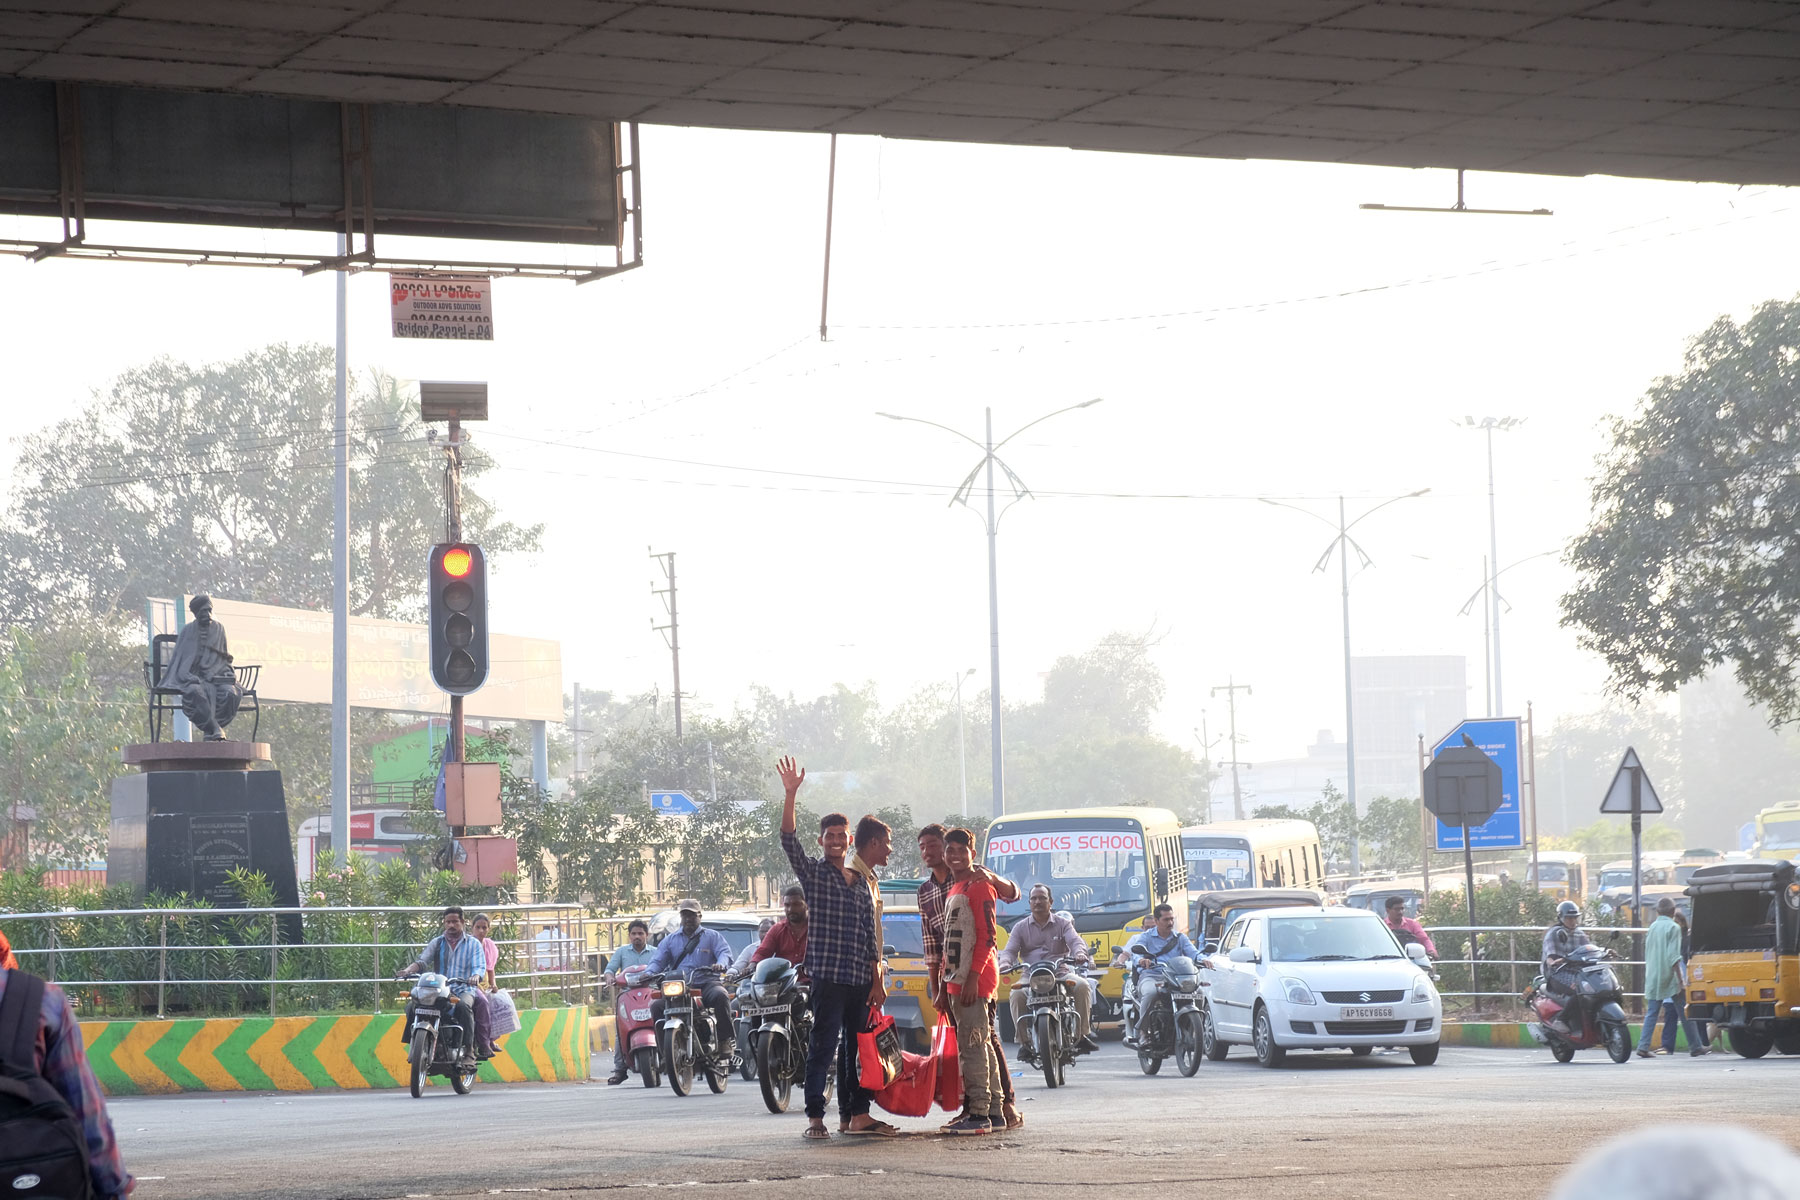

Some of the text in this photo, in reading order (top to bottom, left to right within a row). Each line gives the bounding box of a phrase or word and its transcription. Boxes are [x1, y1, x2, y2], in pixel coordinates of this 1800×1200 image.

[413, 301, 482, 311] OUTDOOR ADVG SOLUTIONS
[988, 835, 1144, 856] POLLOCKS SCHOOL
